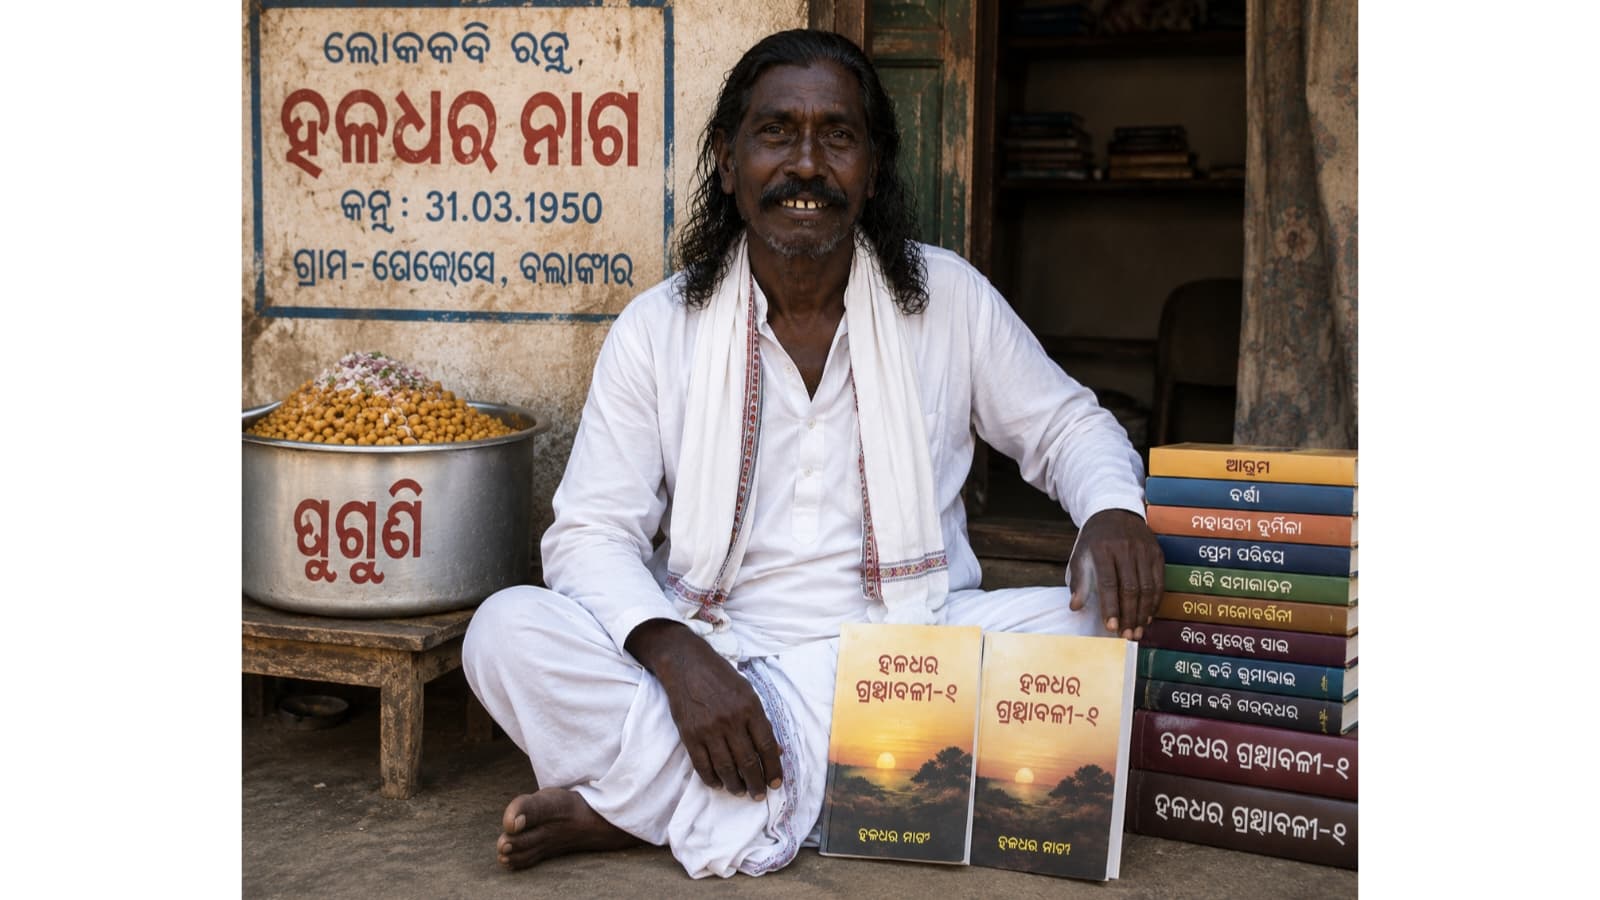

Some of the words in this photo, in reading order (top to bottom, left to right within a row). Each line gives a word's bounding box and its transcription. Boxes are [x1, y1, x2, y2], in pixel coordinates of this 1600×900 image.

[323, 22, 491, 66] ଲୋକକବି
[281, 88, 498, 179] ହଳଧର
[520, 91, 639, 168] ନାଗ
[425, 190, 603, 224] 31.03.1950
[1198, 545, 1231, 563] ପ୍ରେମ
[878, 654, 939, 676] ହଳଧର
[1019, 673, 1081, 697] ହଳଧର
[1160, 732, 1229, 763] ହଳଧର
[1155, 793, 1224, 826] ହଳଧର
